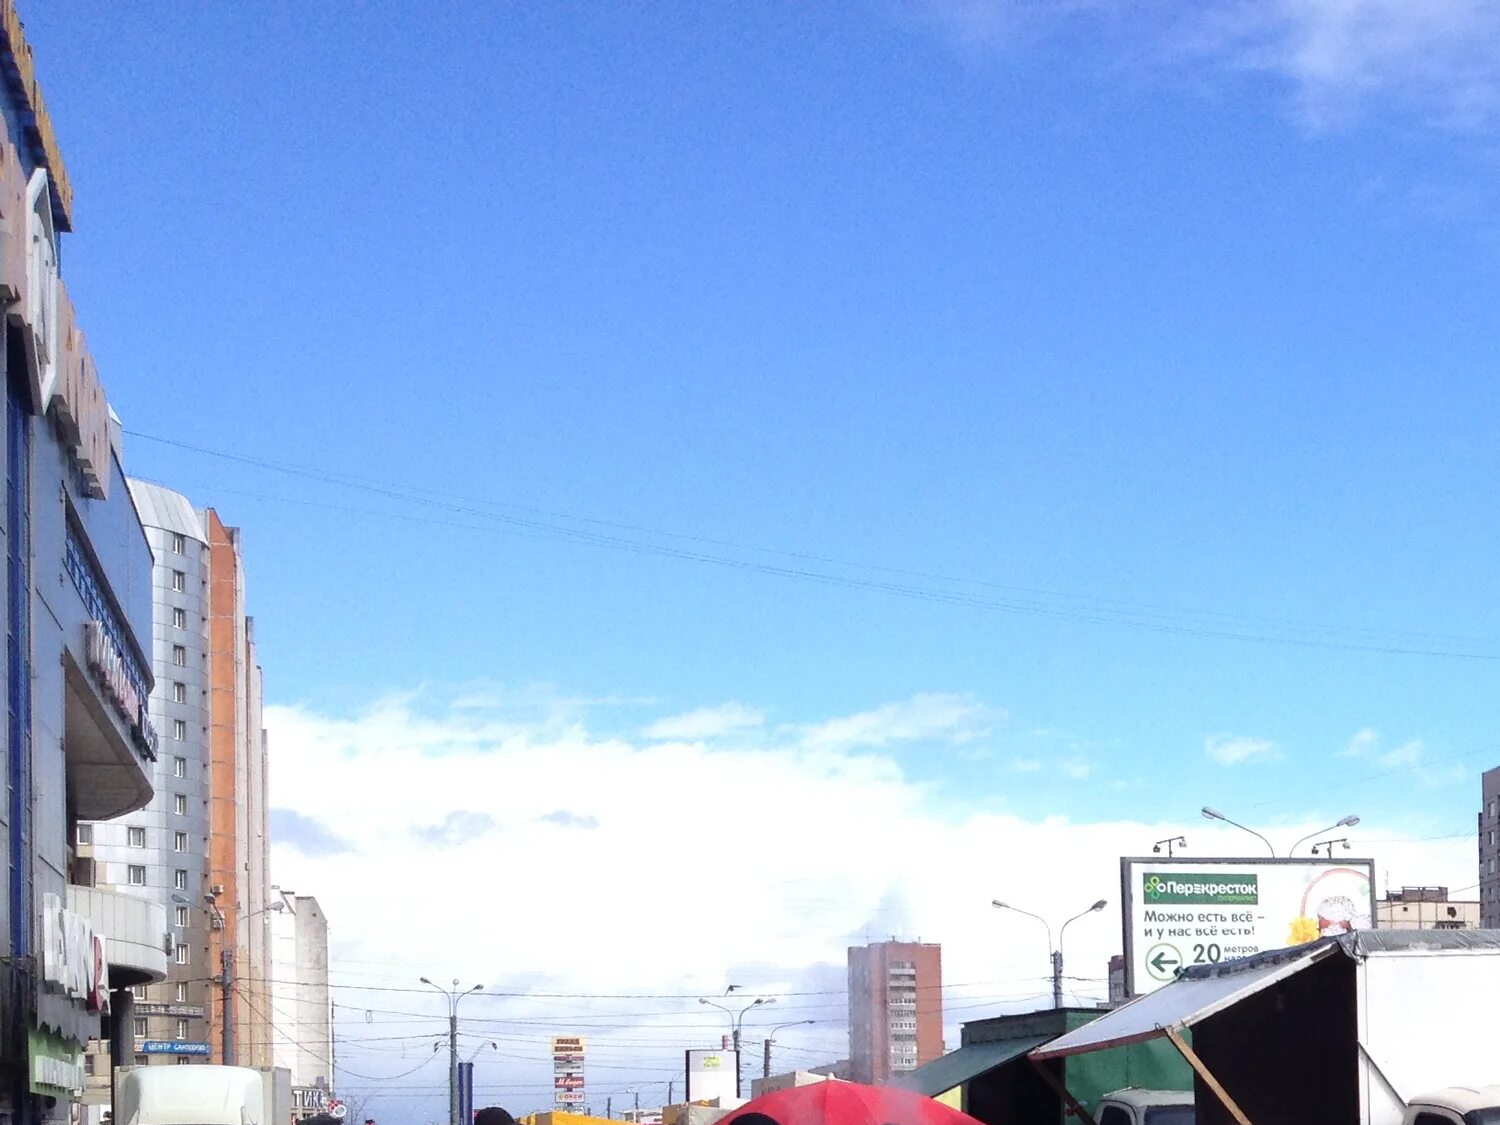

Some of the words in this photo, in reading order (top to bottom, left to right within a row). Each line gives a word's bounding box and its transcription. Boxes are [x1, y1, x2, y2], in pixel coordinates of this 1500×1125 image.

[1167, 881, 1258, 896] Перекресток
[1144, 910, 1194, 923] Можно
[1198, 912, 1227, 923] есть
[1231, 910, 1253, 923] всё
[1144, 928, 1152, 937] и
[1157, 927, 1164, 940] у
[1168, 927, 1192, 937] нас
[1195, 925, 1218, 937] всё
[1222, 925, 1255, 936] есть!
[1193, 943, 1222, 964] 20
[1223, 945, 1259, 955] метров
